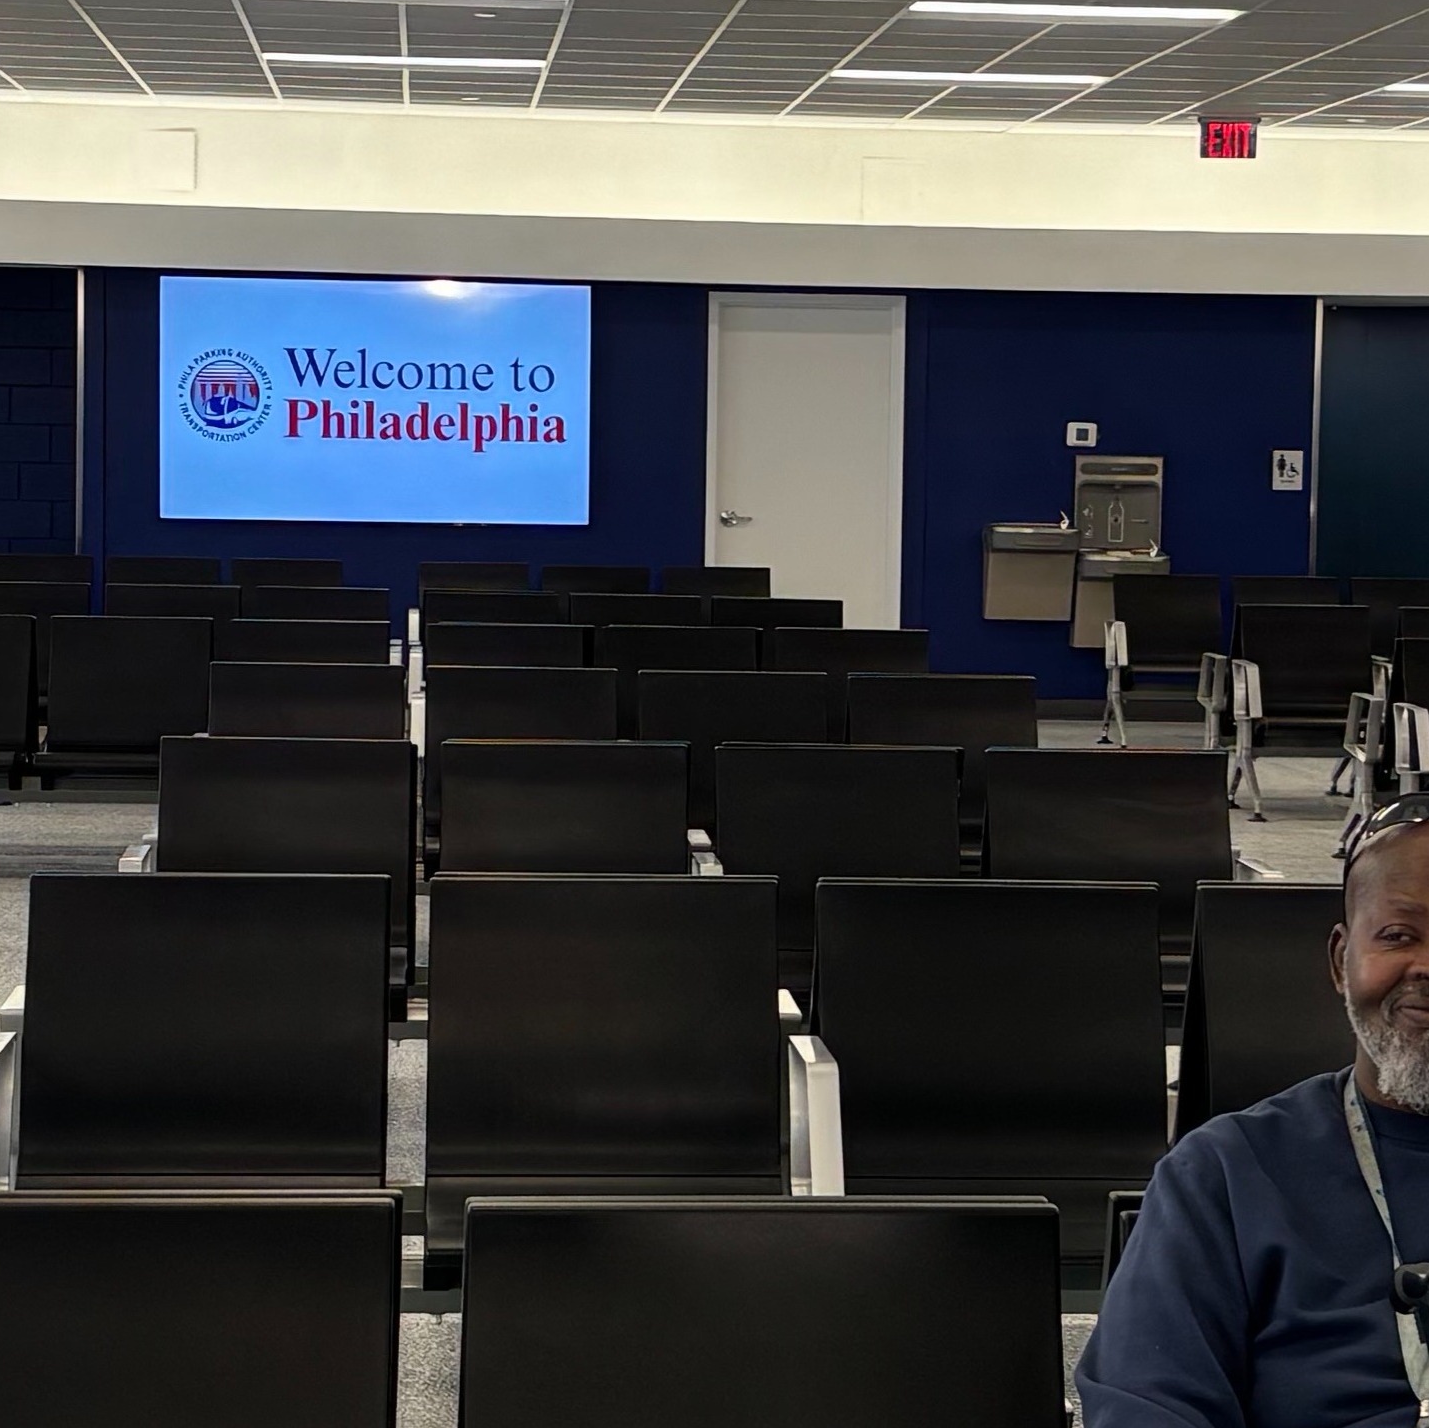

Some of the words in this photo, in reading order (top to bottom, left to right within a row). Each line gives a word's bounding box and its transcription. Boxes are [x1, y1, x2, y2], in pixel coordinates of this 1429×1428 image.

[1208, 123, 1252, 157] EXIT
[236, 351, 273, 391] AUTHORITY
[283, 347, 494, 392] Welcome
[509, 356, 555, 392] to
[179, 402, 247, 442] TRANSPORTATION
[247, 404, 272, 434] CENTER
[283, 398, 568, 453] Philadelphia
